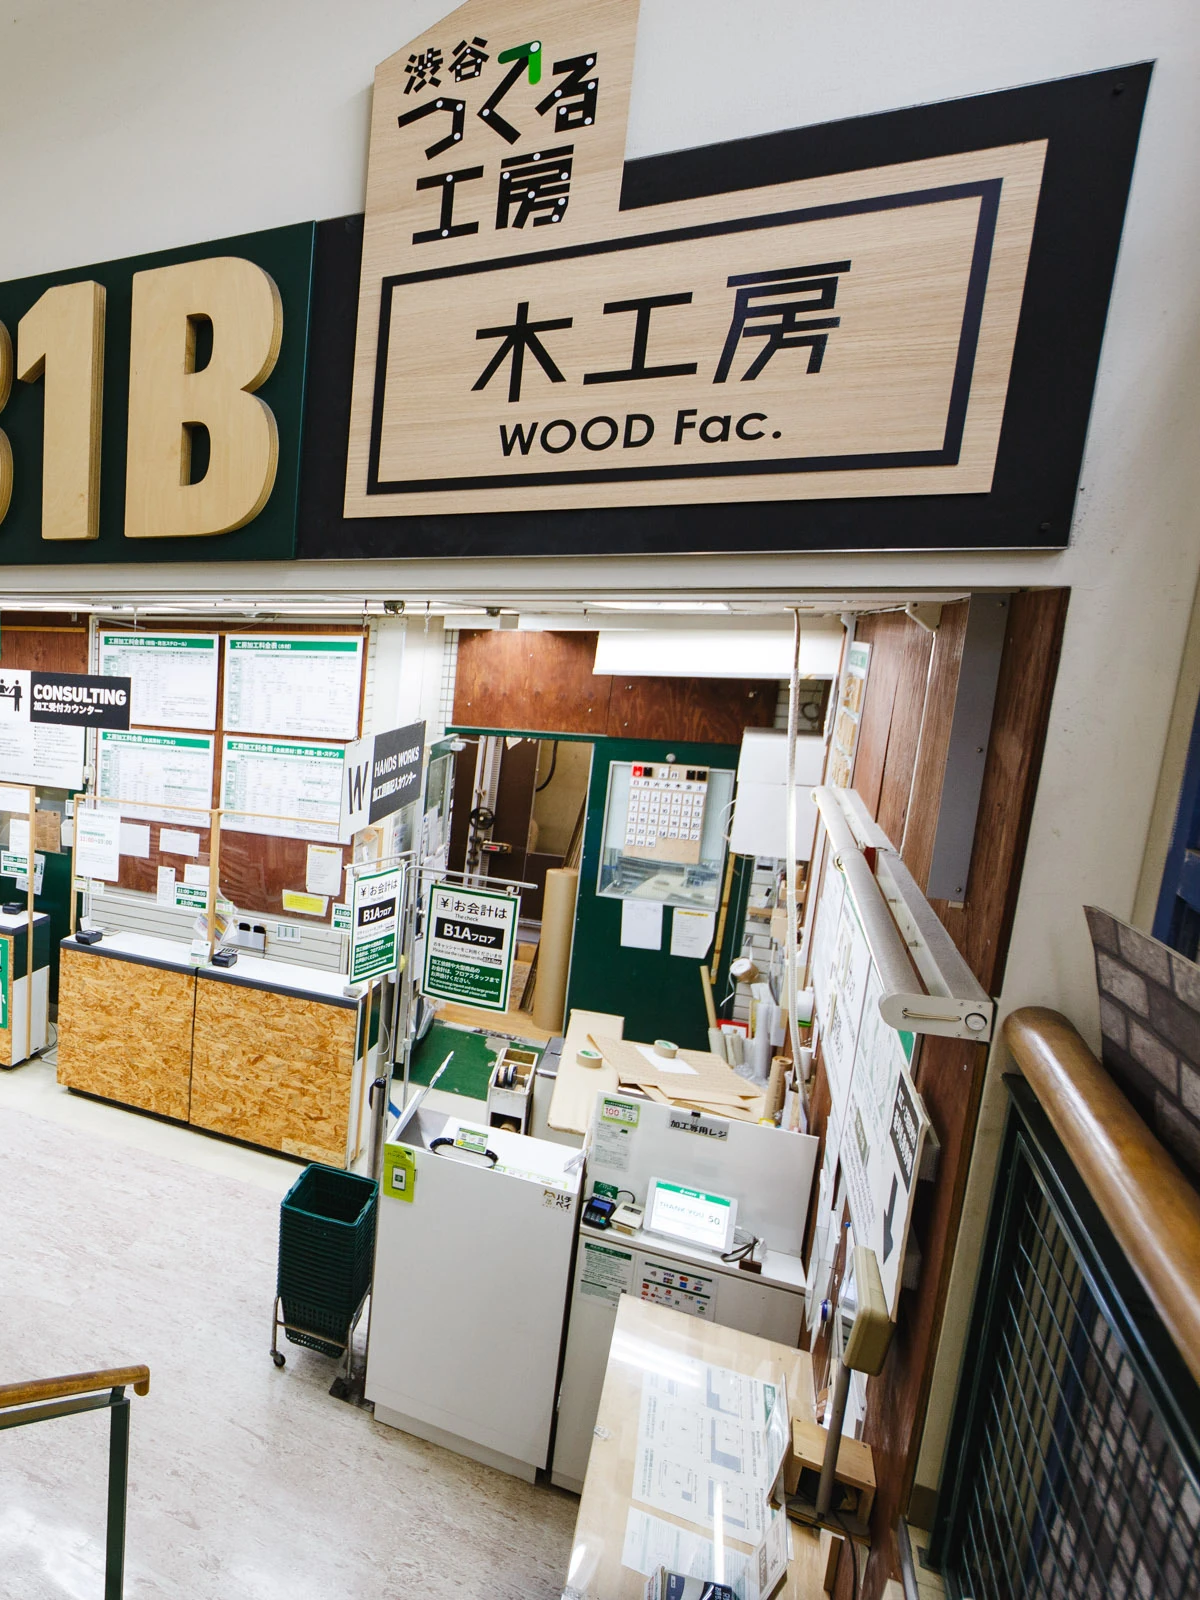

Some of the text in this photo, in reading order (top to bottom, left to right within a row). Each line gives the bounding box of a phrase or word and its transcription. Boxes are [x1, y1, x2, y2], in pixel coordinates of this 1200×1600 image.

[403, 36, 491, 95] 渋谷
[397, 40, 599, 160] つくる
[412, 144, 574, 246] 工房
[471, 259, 852, 403] 木工房
[498, 407, 783, 457] WOOD Fac.
[33, 683, 127, 706] CONSULTING
[33, 701, 104, 715] 加工受付カウンター
[374, 745, 420, 778] HANDS WORKS
[348, 761, 369, 815] W
[370, 880, 398, 896] お会計は
[363, 906, 392, 923] B1Aフロア
[454, 899, 508, 919] お会計は
[443, 923, 496, 944] B1Aフロア
